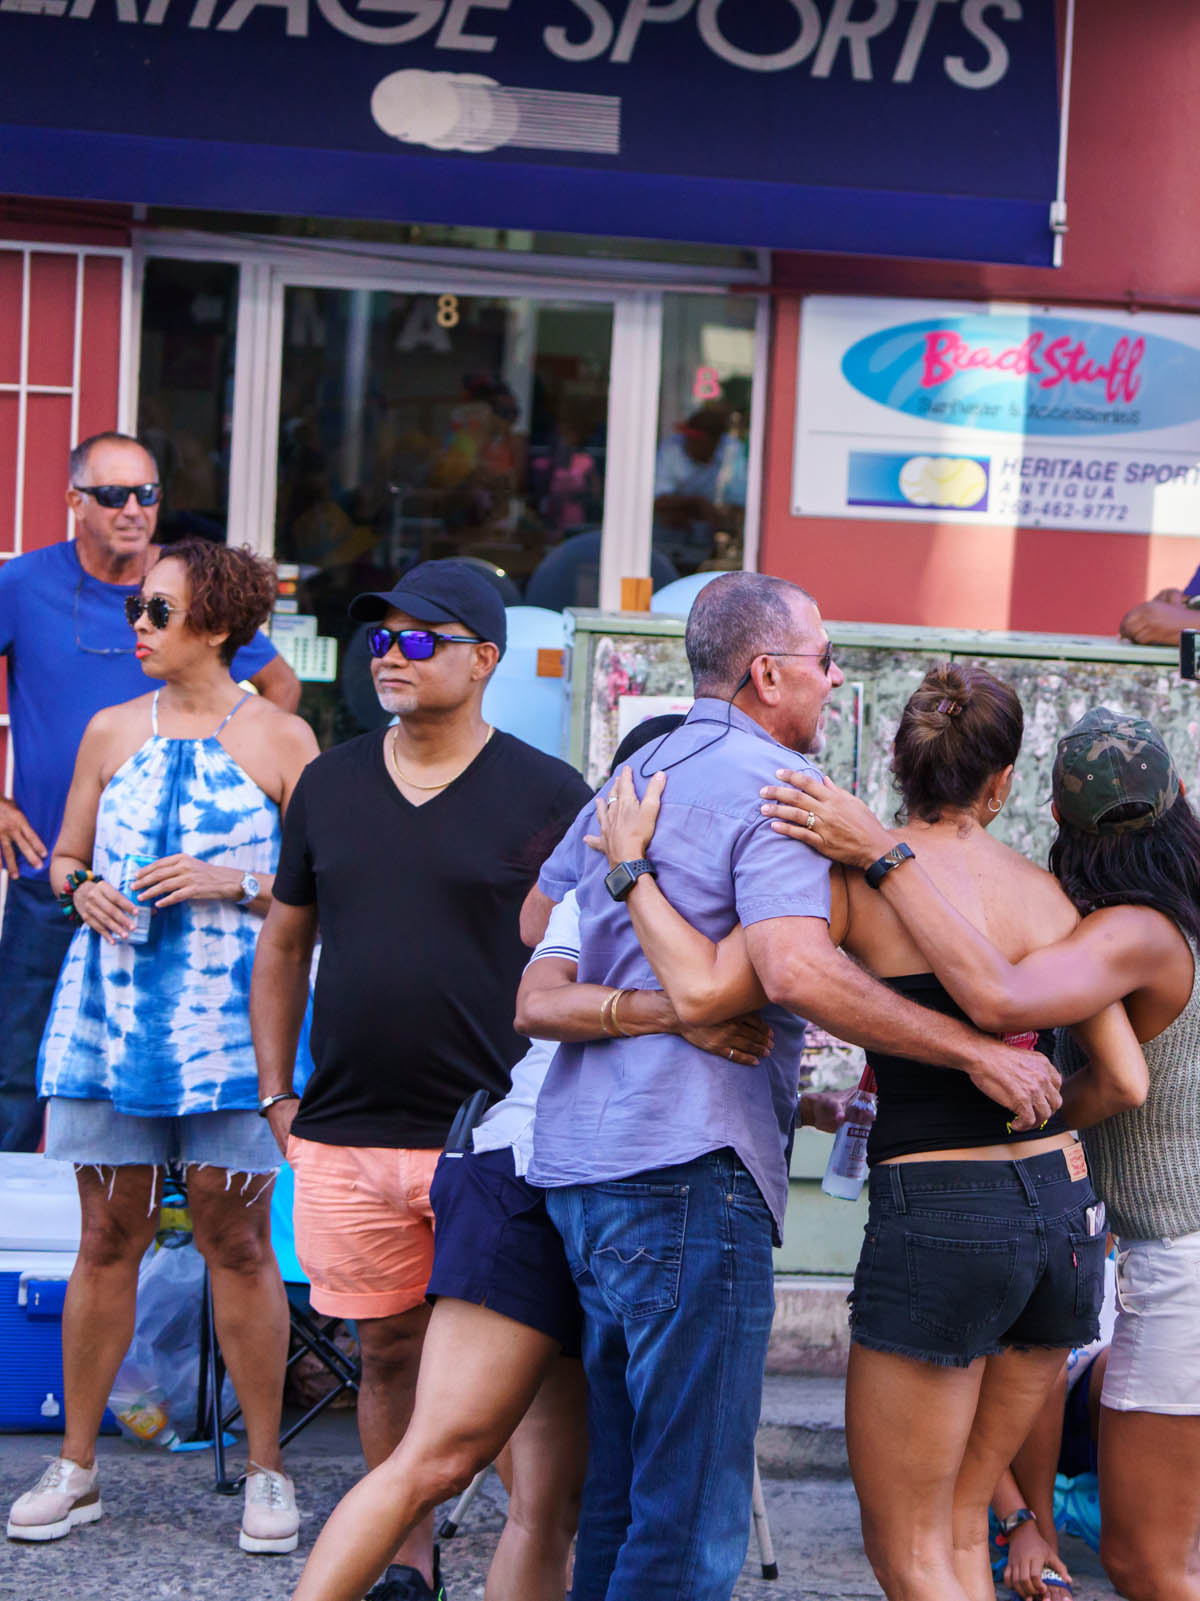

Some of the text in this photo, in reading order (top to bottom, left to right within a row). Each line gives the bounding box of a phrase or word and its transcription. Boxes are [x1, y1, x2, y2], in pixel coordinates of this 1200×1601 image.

[543, 0, 1022, 89] SPORTS
[437, 294, 459, 328] 8
[1040, 335, 1146, 404] Stuff
[1001, 456, 1119, 482] HERITAGE
